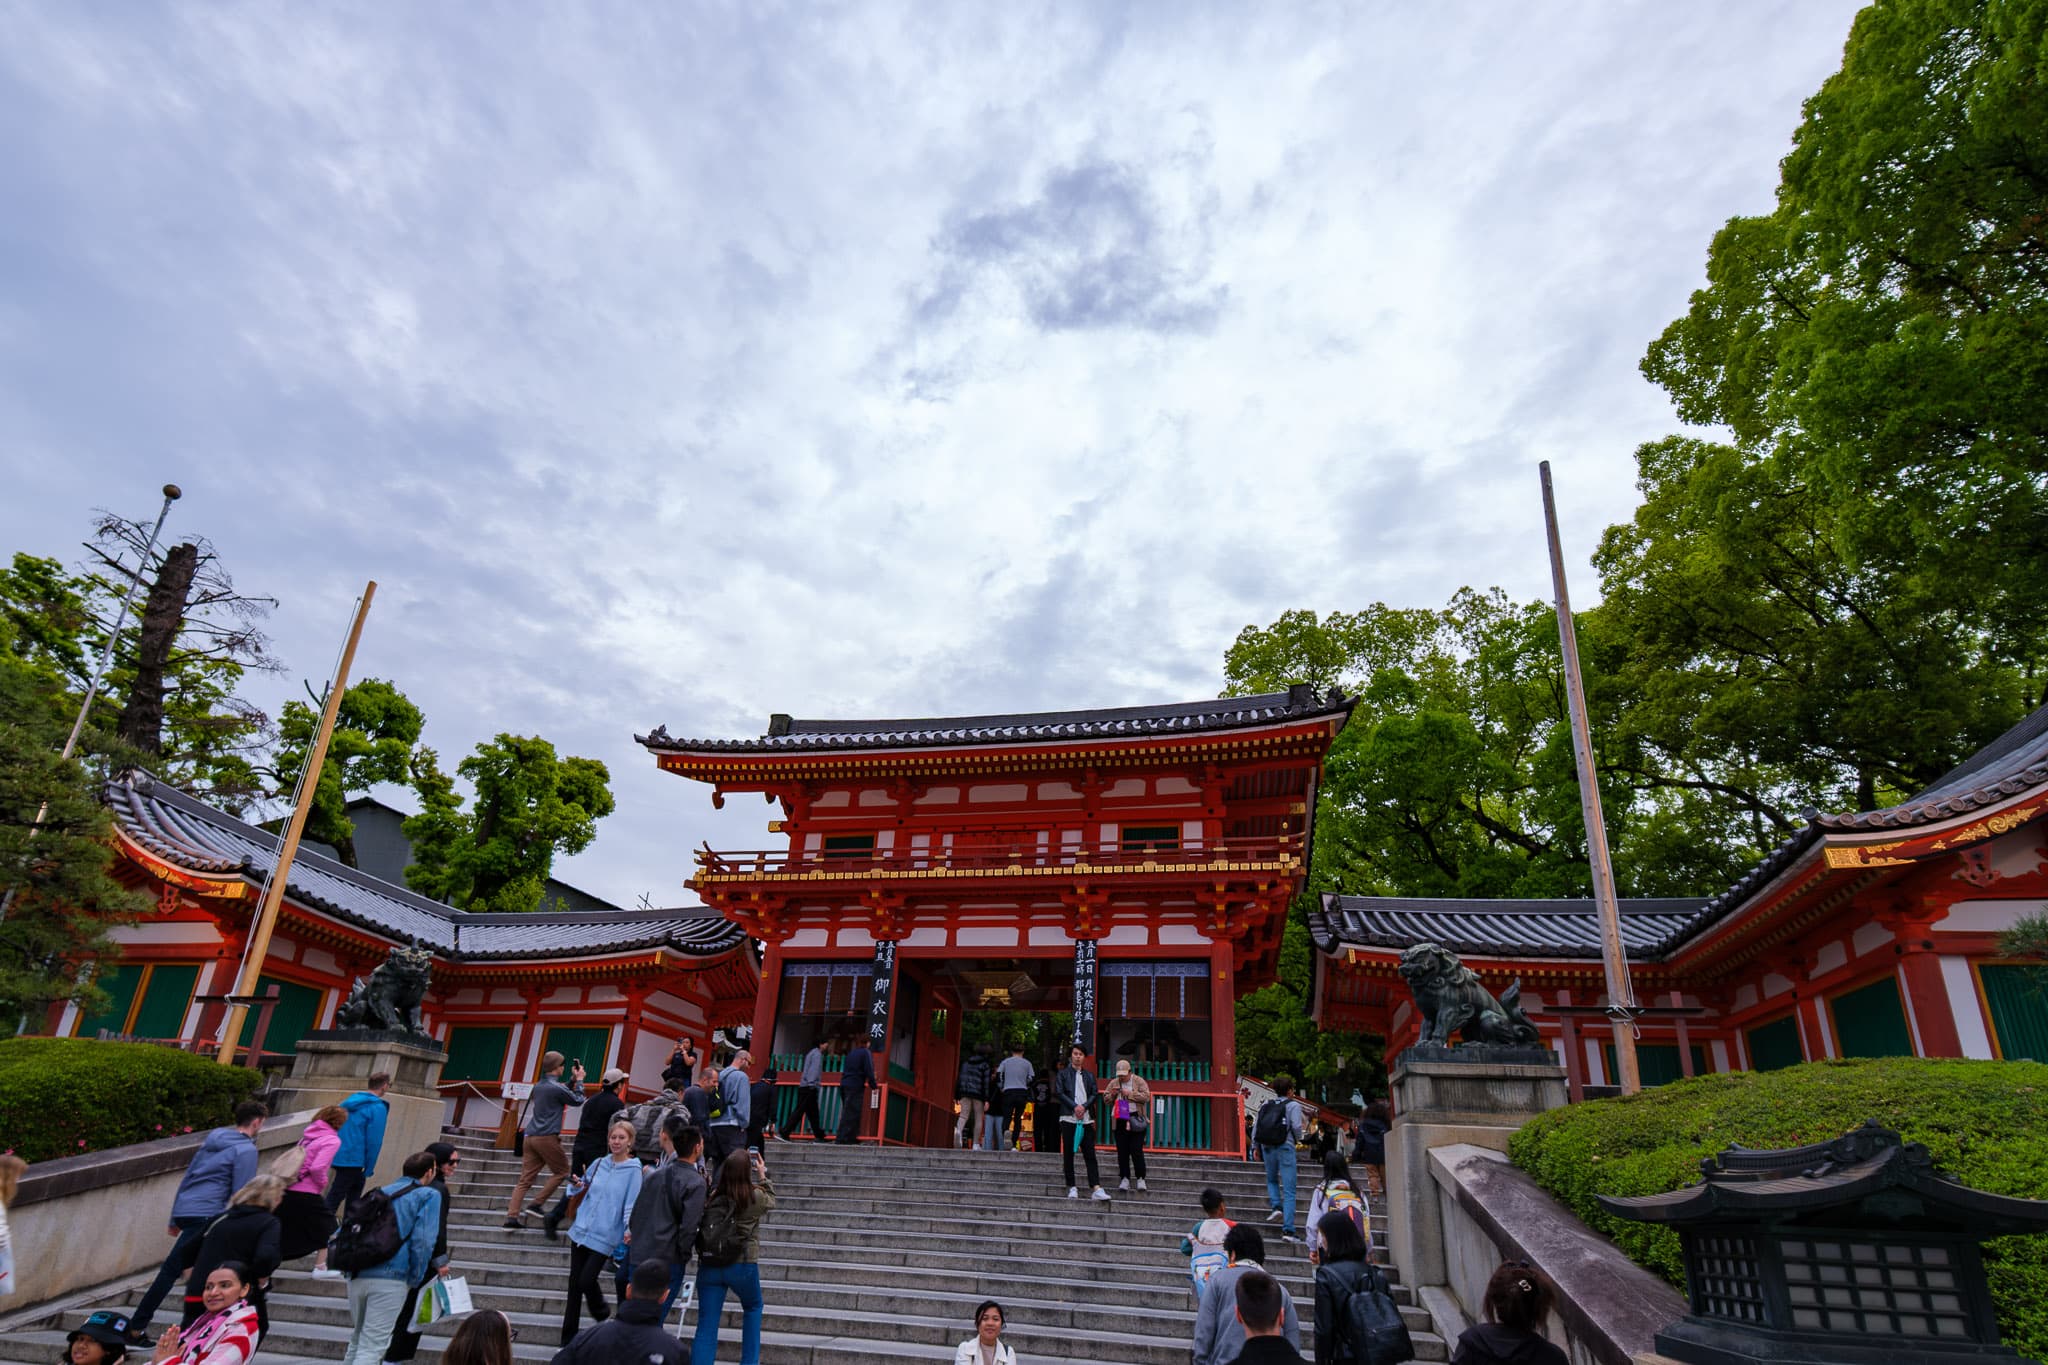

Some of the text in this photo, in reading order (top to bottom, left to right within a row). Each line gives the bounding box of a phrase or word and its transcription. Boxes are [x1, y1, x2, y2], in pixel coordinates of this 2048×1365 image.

[1085, 940, 1096, 974] 五月一日
[871, 978, 889, 1038] 御衣祭
